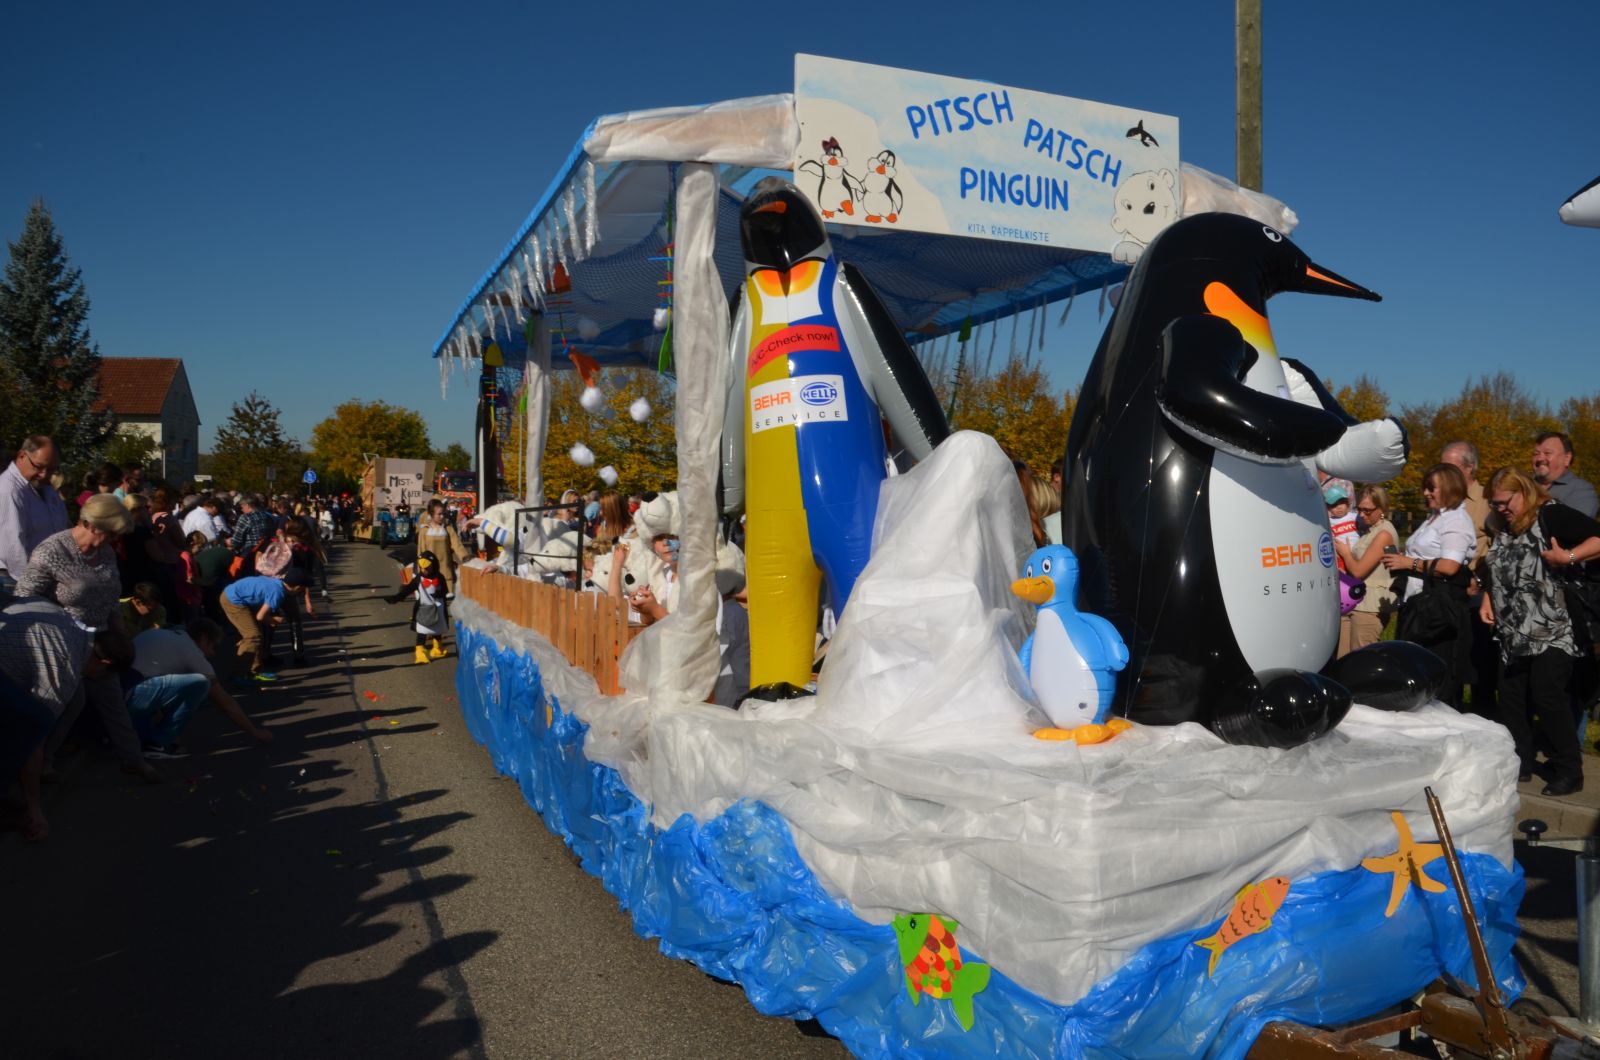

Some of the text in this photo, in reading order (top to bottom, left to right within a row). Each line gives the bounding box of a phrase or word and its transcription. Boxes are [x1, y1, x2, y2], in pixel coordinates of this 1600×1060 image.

[906, 90, 1013, 139] PITSCH
[1023, 118, 1122, 187] PATSCH
[960, 167, 1069, 212] PINGUIN
[967, 223, 986, 234] KITA
[807, 332, 834, 341] now!
[754, 388, 838, 411] BEHR HELLA
[755, 410, 841, 429] SERVICE
[1261, 543, 1313, 568] BEHR
